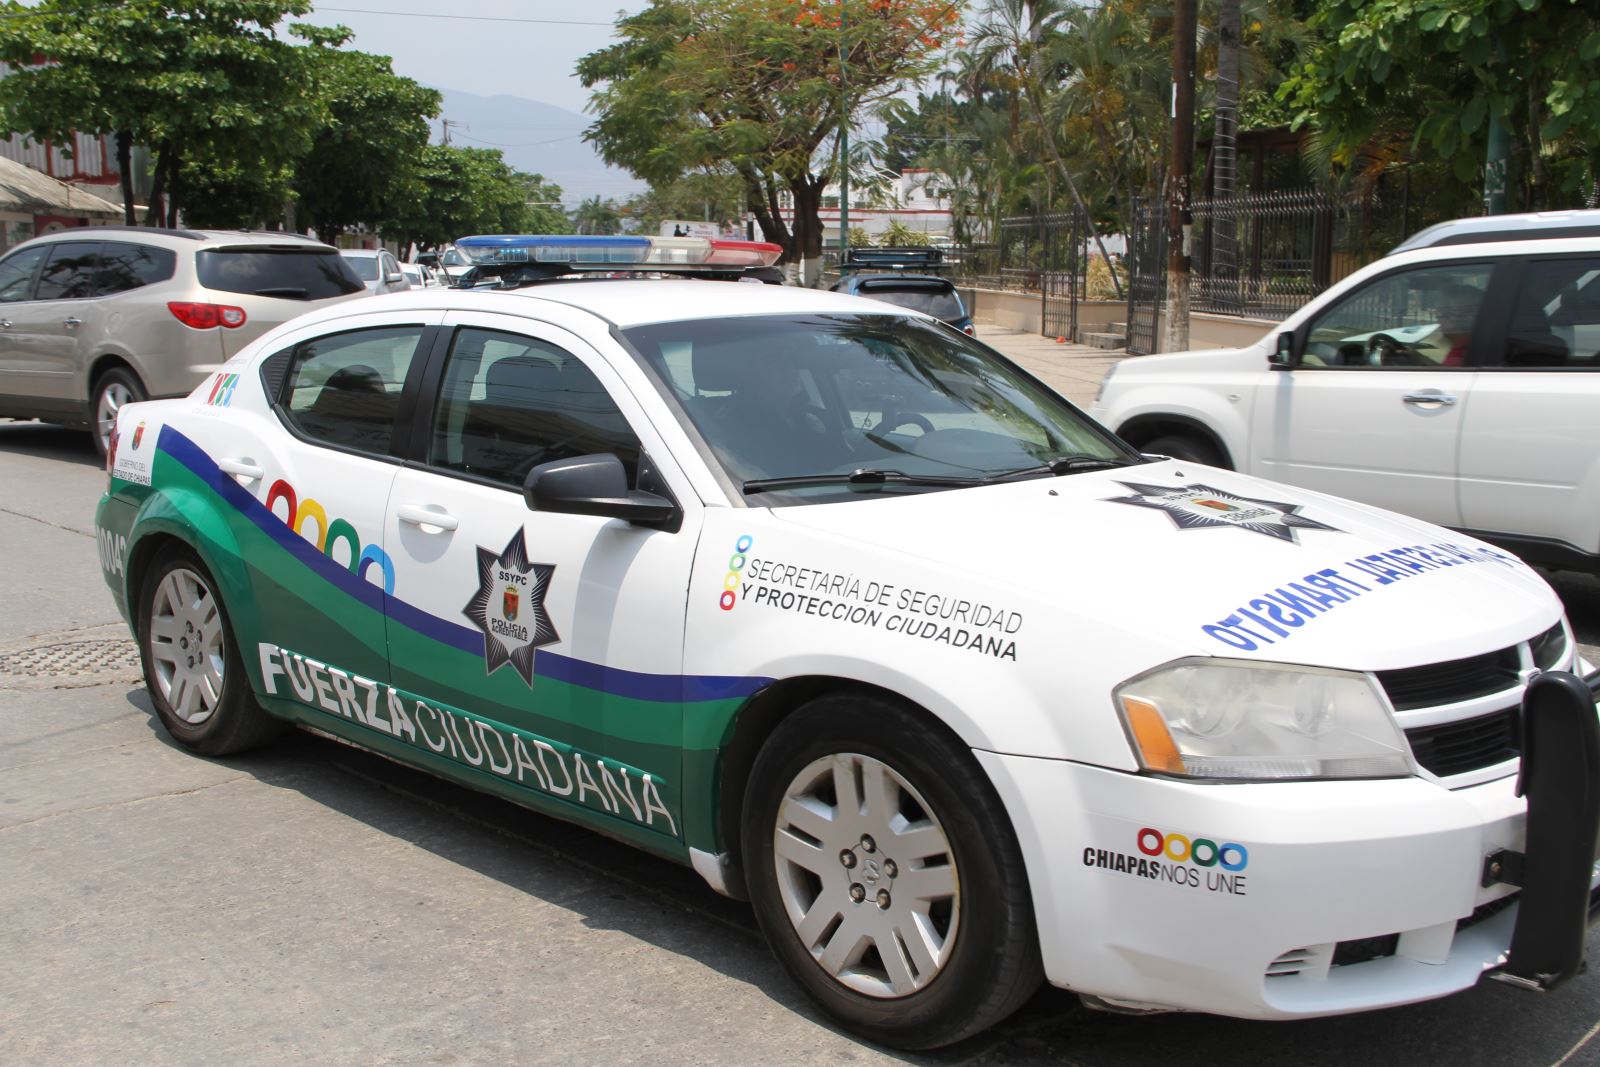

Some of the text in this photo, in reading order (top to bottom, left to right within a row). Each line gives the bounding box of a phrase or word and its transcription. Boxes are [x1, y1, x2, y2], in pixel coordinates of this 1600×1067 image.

[498, 570, 527, 586] SSYPC
[747, 558, 1023, 634] SECRETARÍA DE SEGURIDAD
[491, 618, 528, 634] POLICIA
[491, 625, 528, 642] ACREDITABLE
[741, 583, 754, 600] Y
[885, 614, 1017, 661] CIUDADANA
[258, 642, 678, 837] FUERZA CIUDADANA
[1083, 847, 1247, 896] CHIAPAS NOS UNE
